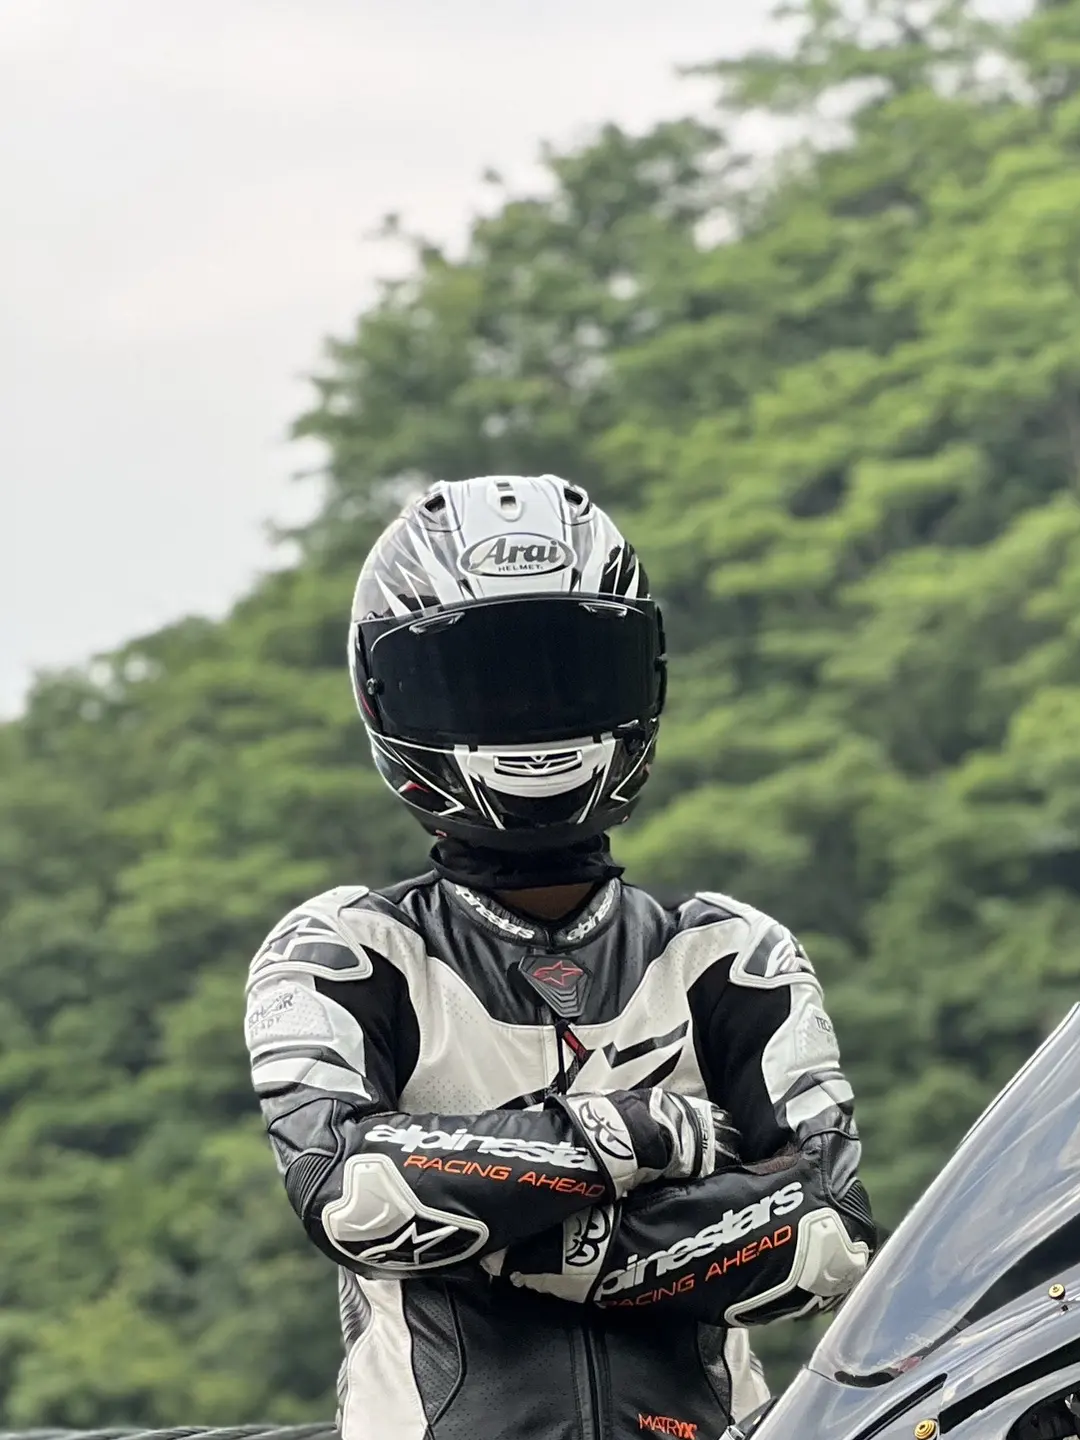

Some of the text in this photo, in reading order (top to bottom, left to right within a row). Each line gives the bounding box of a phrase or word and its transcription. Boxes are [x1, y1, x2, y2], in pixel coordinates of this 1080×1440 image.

[468, 538, 561, 570] Arai
[455, 884, 535, 939] pinestars
[365, 1124, 598, 1172] alpinesta
[403, 1155, 606, 1198] RACING AHEAD
[594, 1181, 804, 1303] pinestars
[705, 1224, 792, 1281] AHEAD
[638, 1413, 697, 1440] MATRYX
